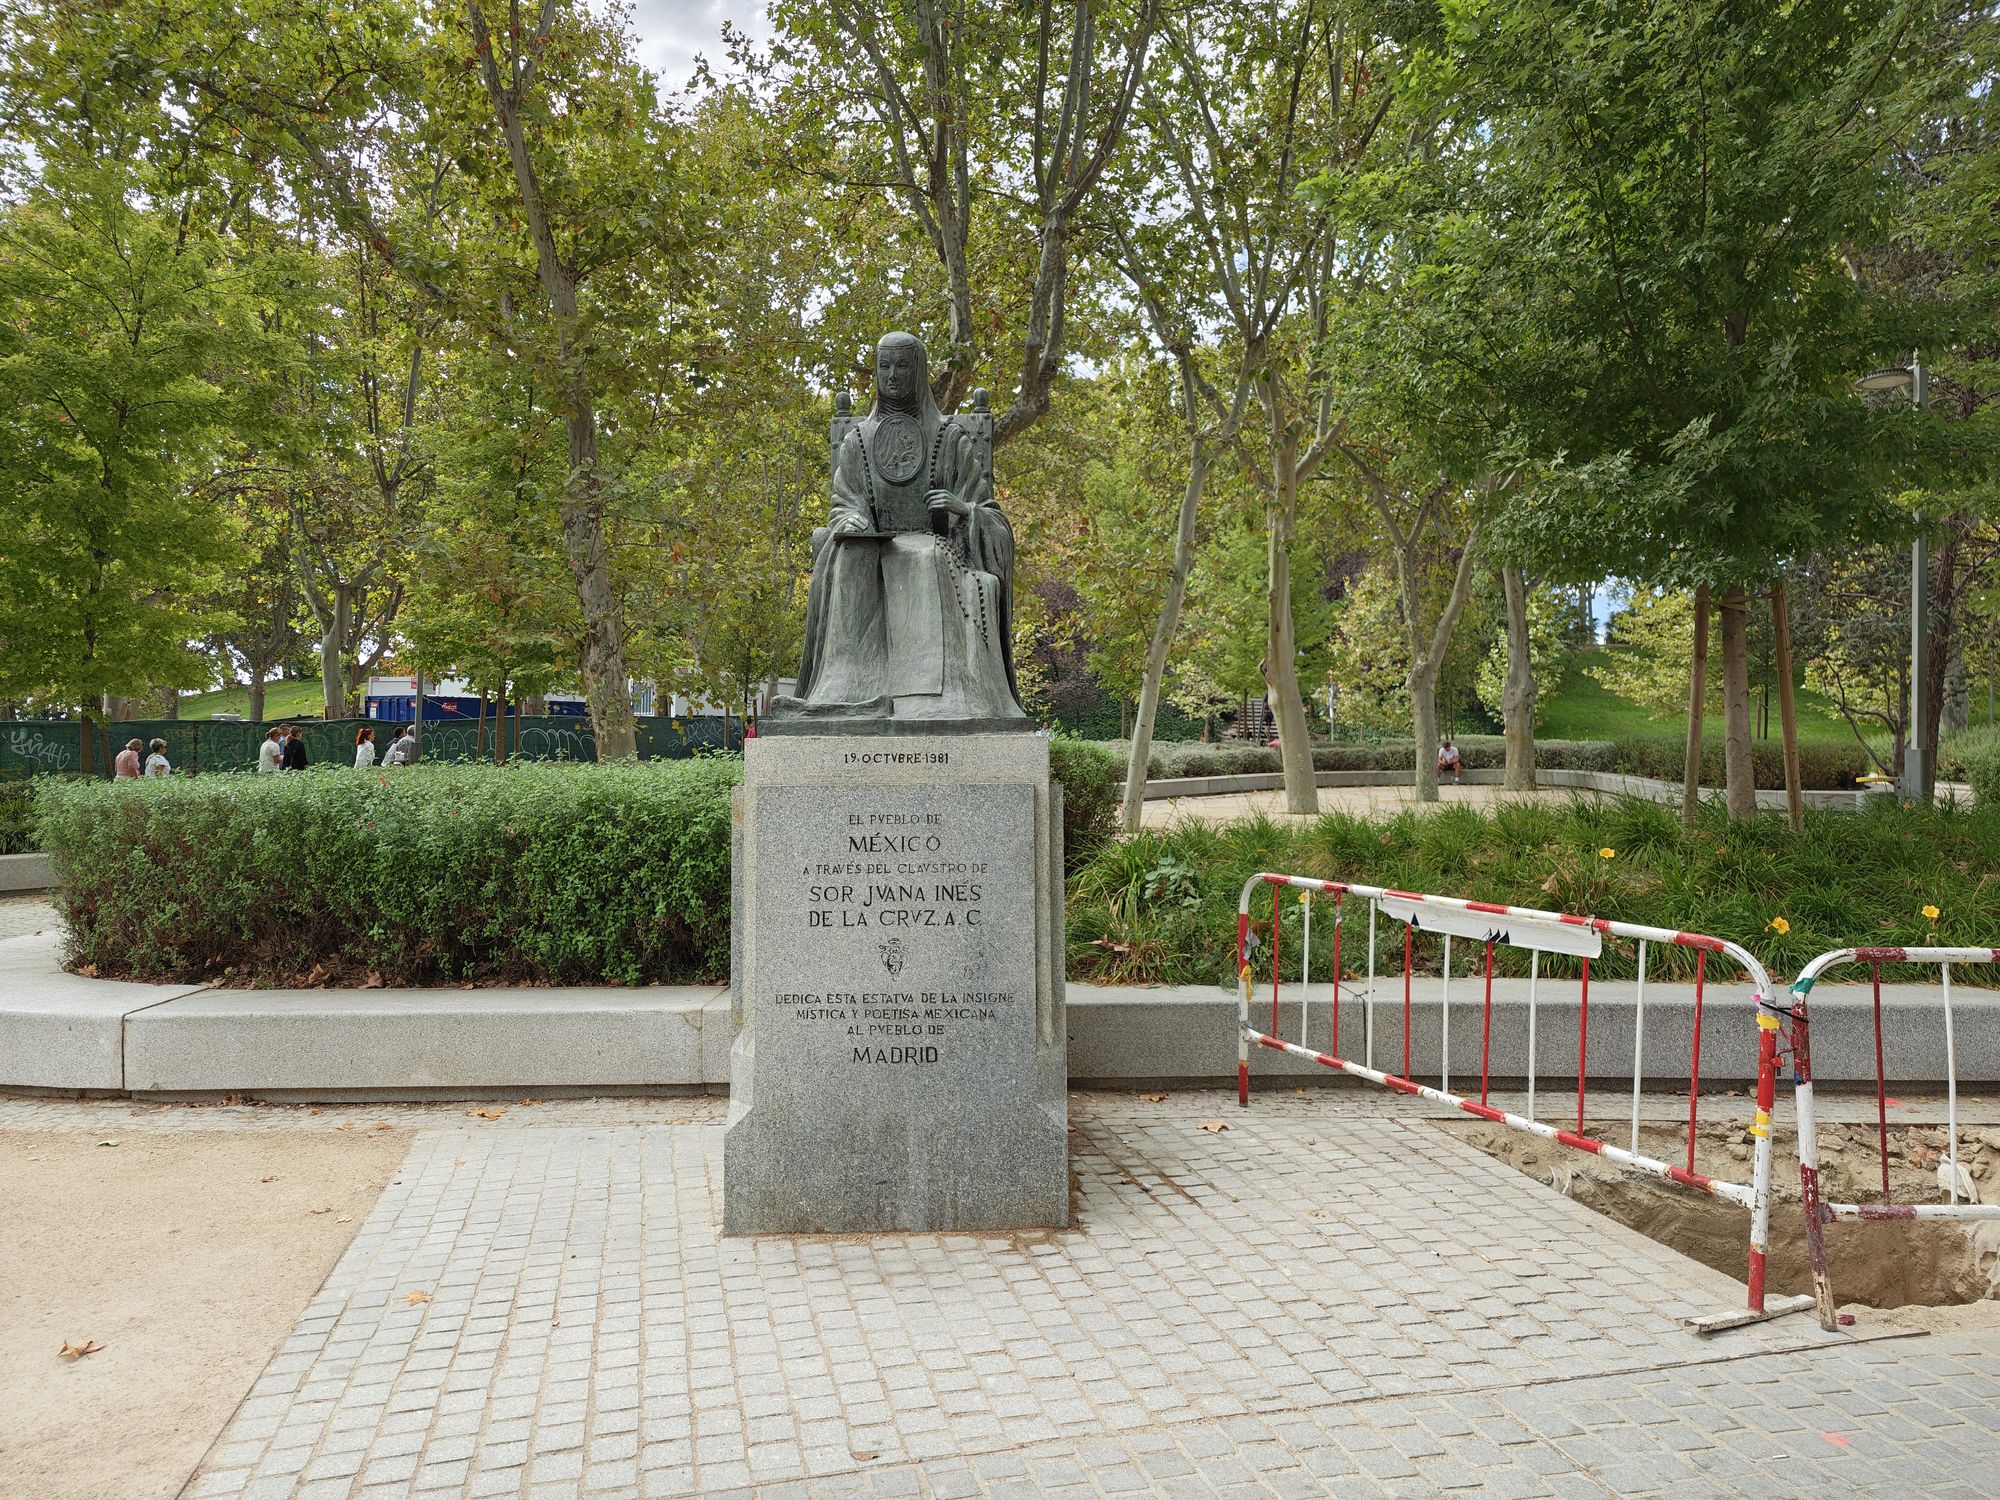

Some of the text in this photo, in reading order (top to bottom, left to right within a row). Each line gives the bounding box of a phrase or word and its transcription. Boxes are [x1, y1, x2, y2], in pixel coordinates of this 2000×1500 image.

[849, 814, 942, 825] EL PVEBLO DE
[849, 832, 941, 853] MÉXICO
[802, 861, 988, 875] A TRAVÉS DEL CLAVSTRO DE
[809, 880, 983, 907] SOR JVANA INÉS
[809, 910, 833, 927] DE
[843, 910, 868, 927] LA
[775, 992, 1015, 1005] DEDICA ESTA ESTATVA DE LA INSIGNE
[852, 1009, 859, 1019] Y
[864, 1009, 919, 1020] POETISA
[924, 1008, 997, 1020] MEXICANA
[847, 1024, 944, 1036] AL PVEBLO DE
[853, 1046, 938, 1066] MADRID
